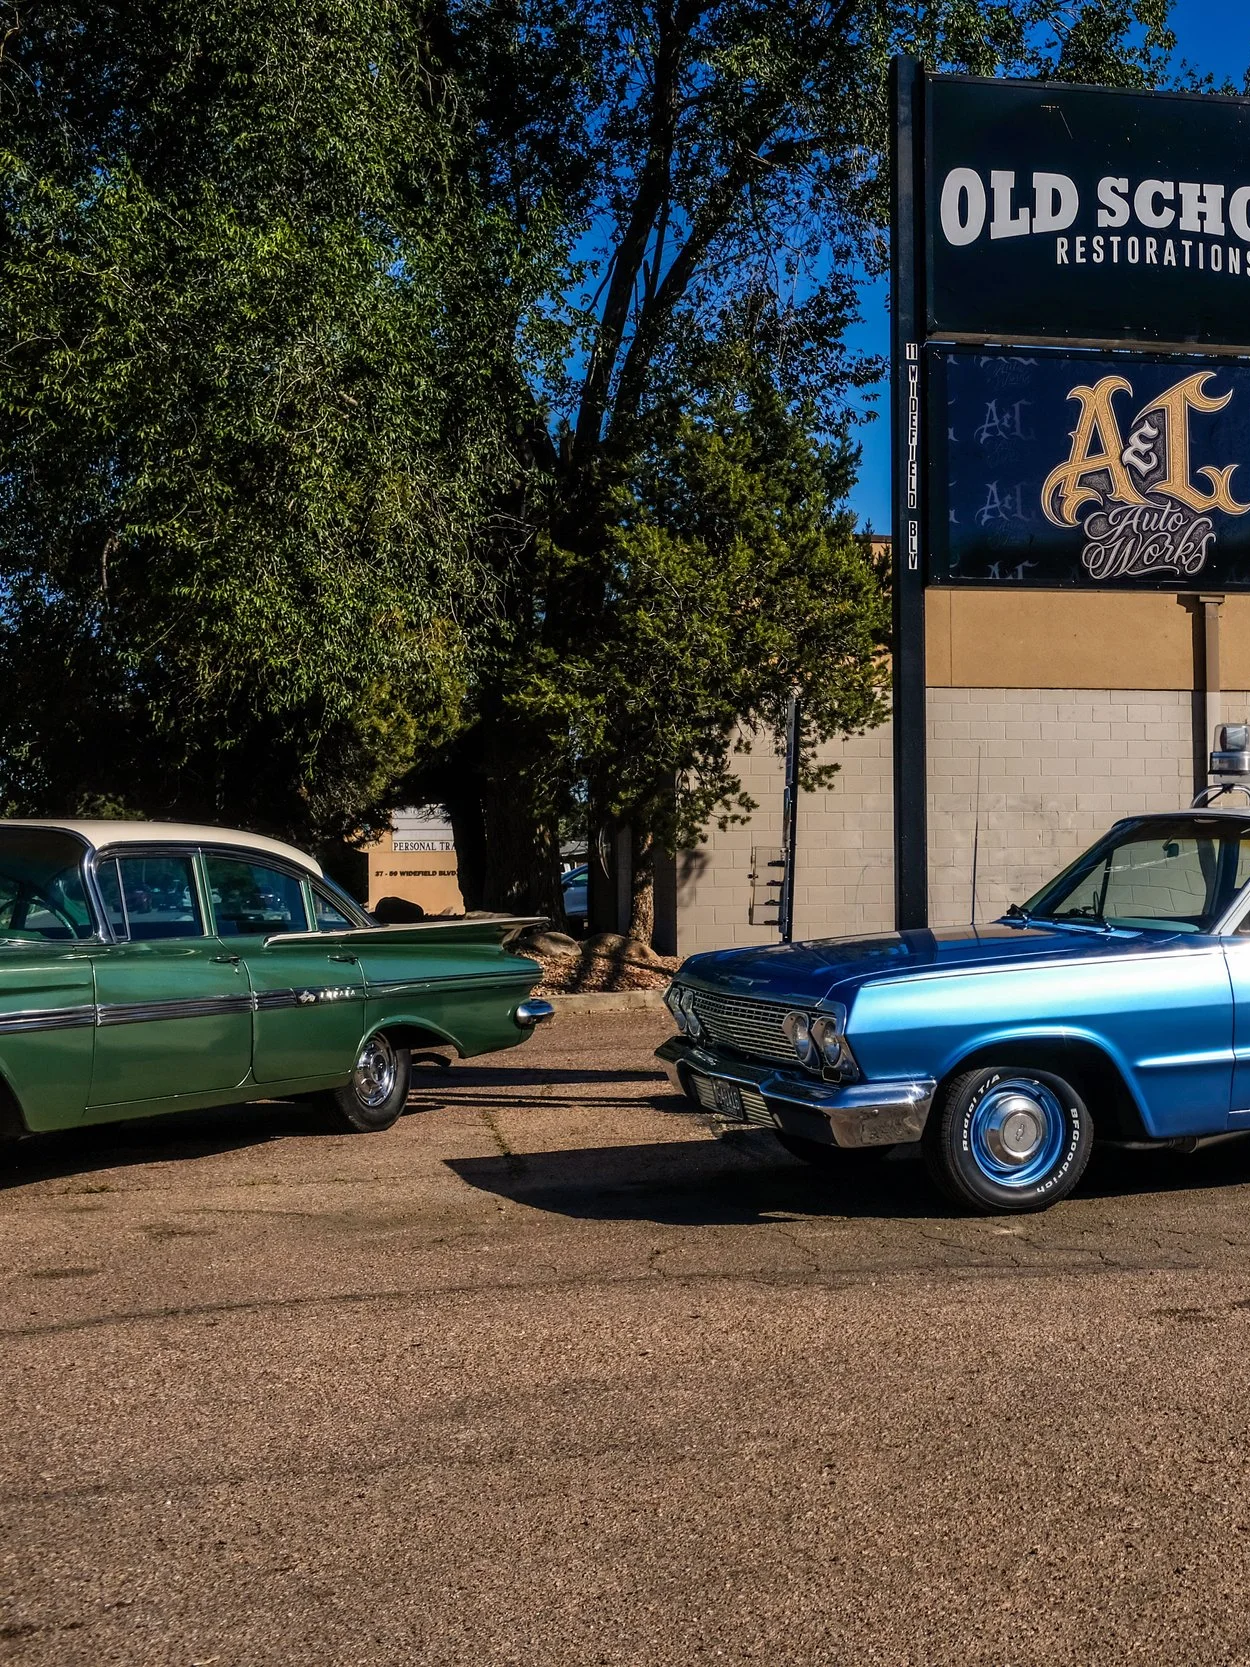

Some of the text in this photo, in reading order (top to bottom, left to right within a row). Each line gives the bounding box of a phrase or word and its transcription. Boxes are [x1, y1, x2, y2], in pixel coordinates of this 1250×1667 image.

[940, 167, 1079, 246] OLD
[907, 344, 918, 569] 11 WIDEFIELD BLV
[1082, 517, 1216, 579] Works
[1084, 500, 1188, 545] Auto
[393, 842, 436, 851] PERSONAL
[962, 1074, 1000, 1151] Radial T/A
[1036, 1108, 1080, 1193] BFGoodrich
